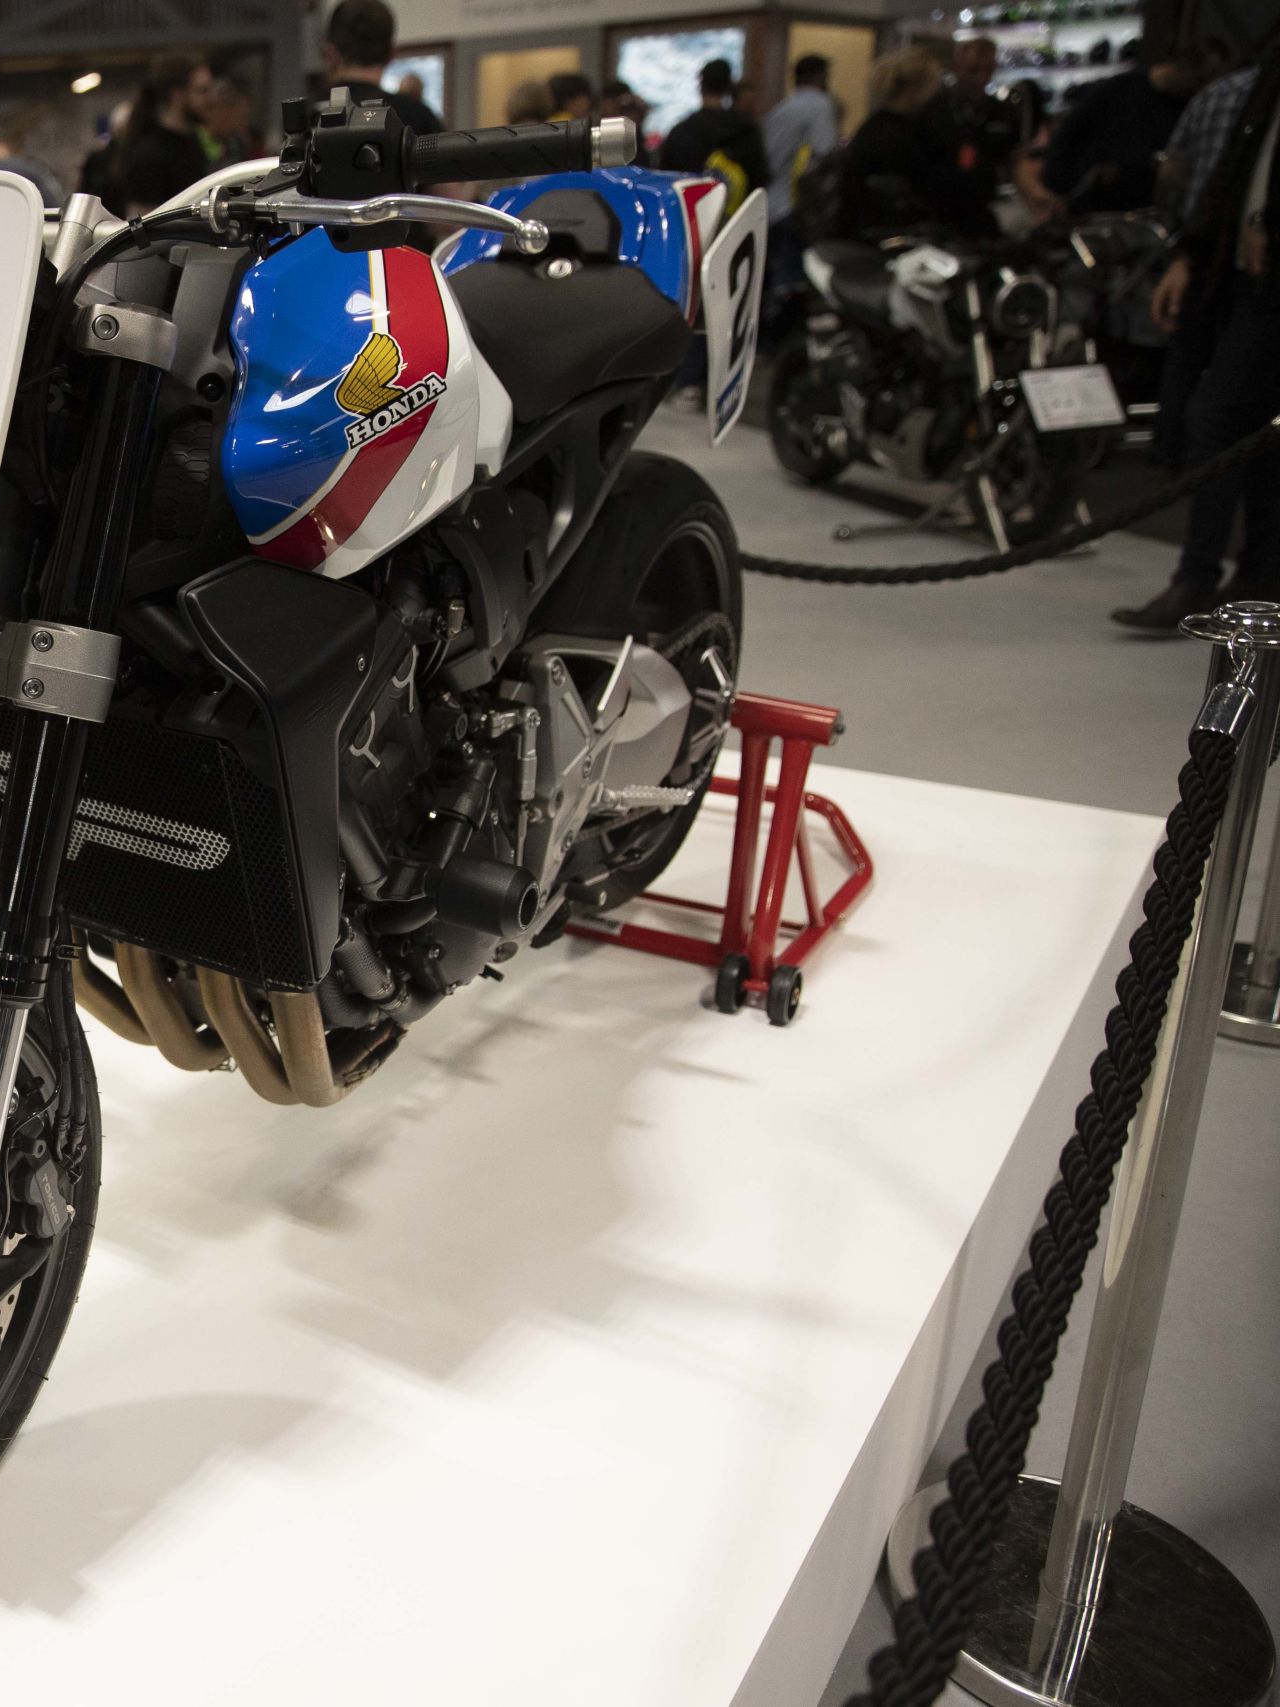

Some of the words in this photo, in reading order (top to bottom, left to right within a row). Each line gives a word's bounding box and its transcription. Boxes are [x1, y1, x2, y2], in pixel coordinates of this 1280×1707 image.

[728, 231, 756, 370] 2
[347, 375, 447, 447] HONDA
[42, 1173, 61, 1225] TOKICO
